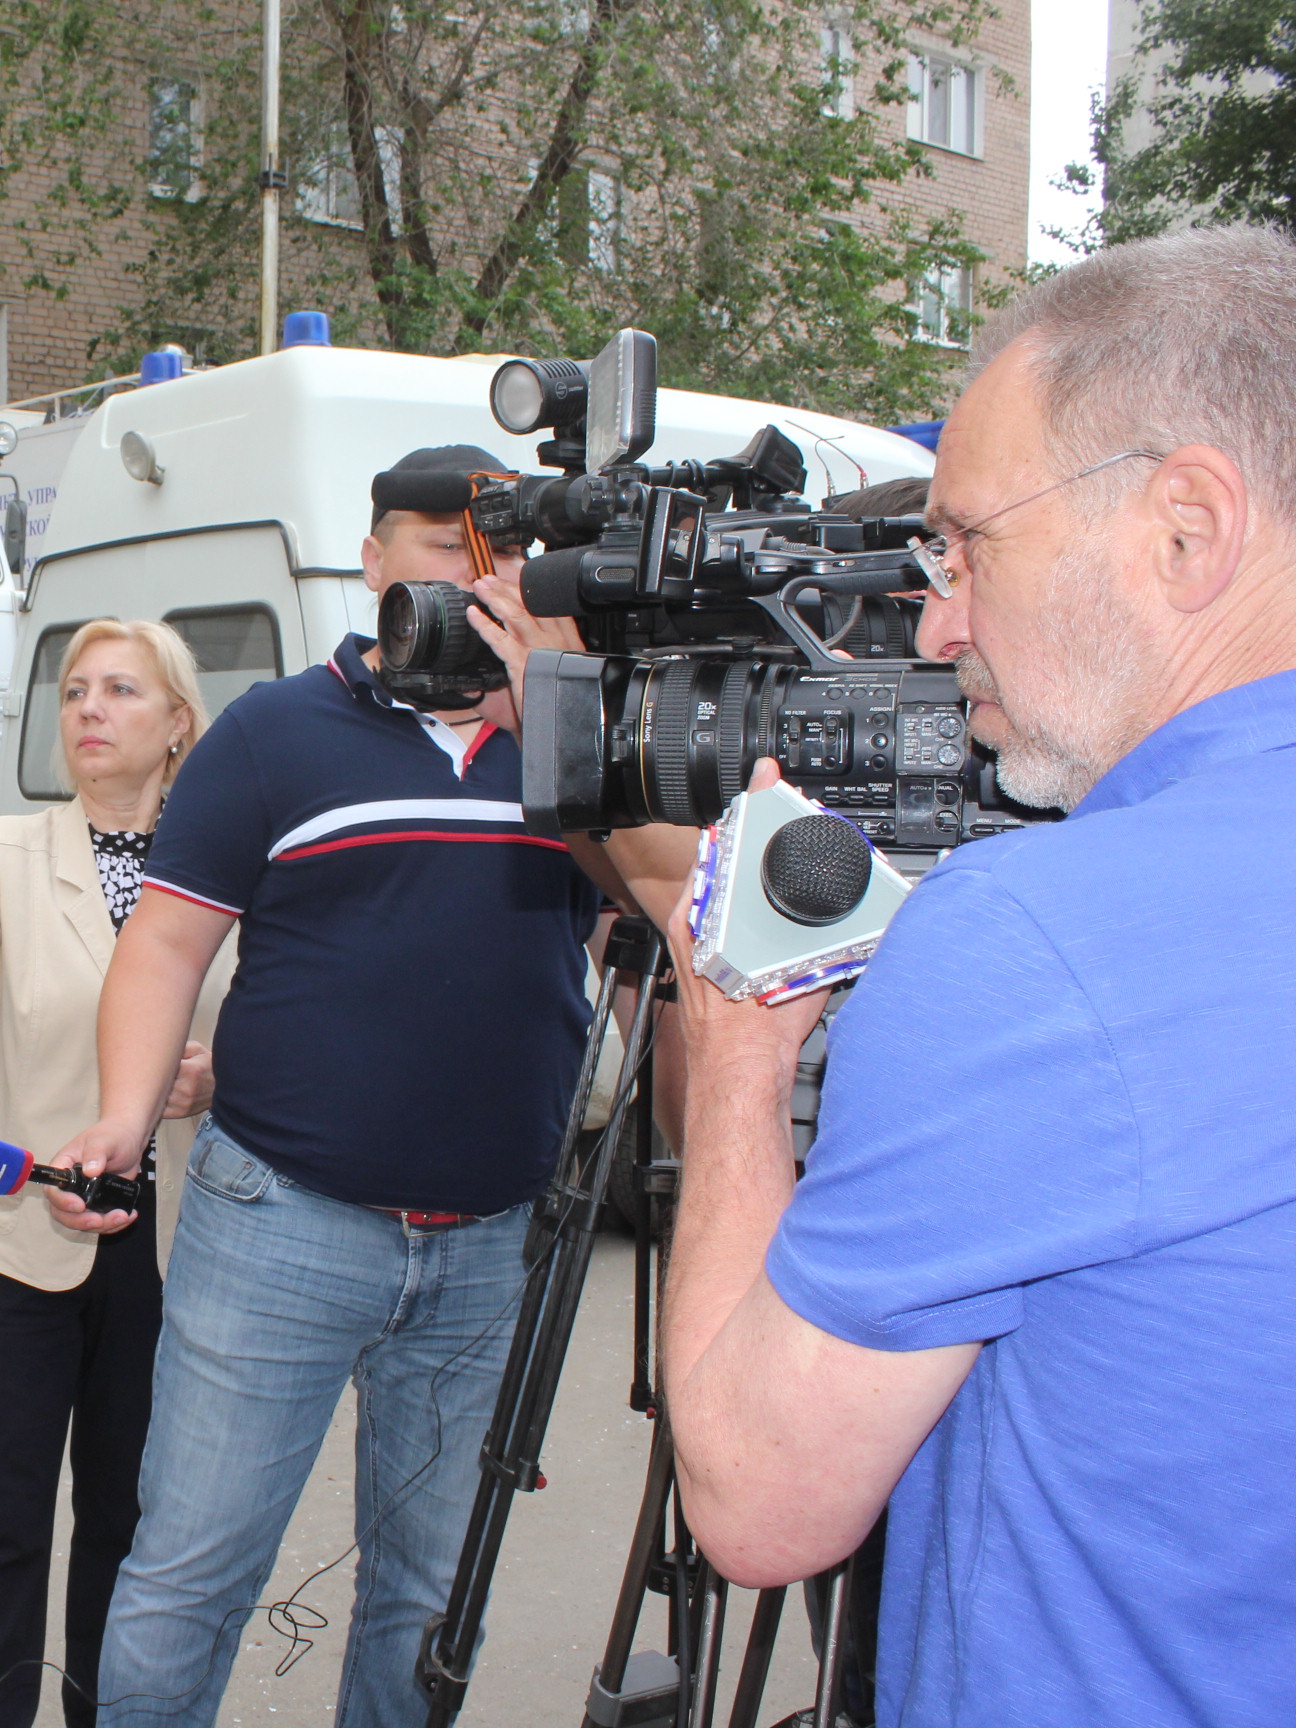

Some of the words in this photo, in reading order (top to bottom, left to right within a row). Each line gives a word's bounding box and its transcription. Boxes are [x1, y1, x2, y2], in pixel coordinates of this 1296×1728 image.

[697, 702, 717, 711] 20x
[644, 707, 653, 724] Lens
[643, 725, 653, 743] Sony
